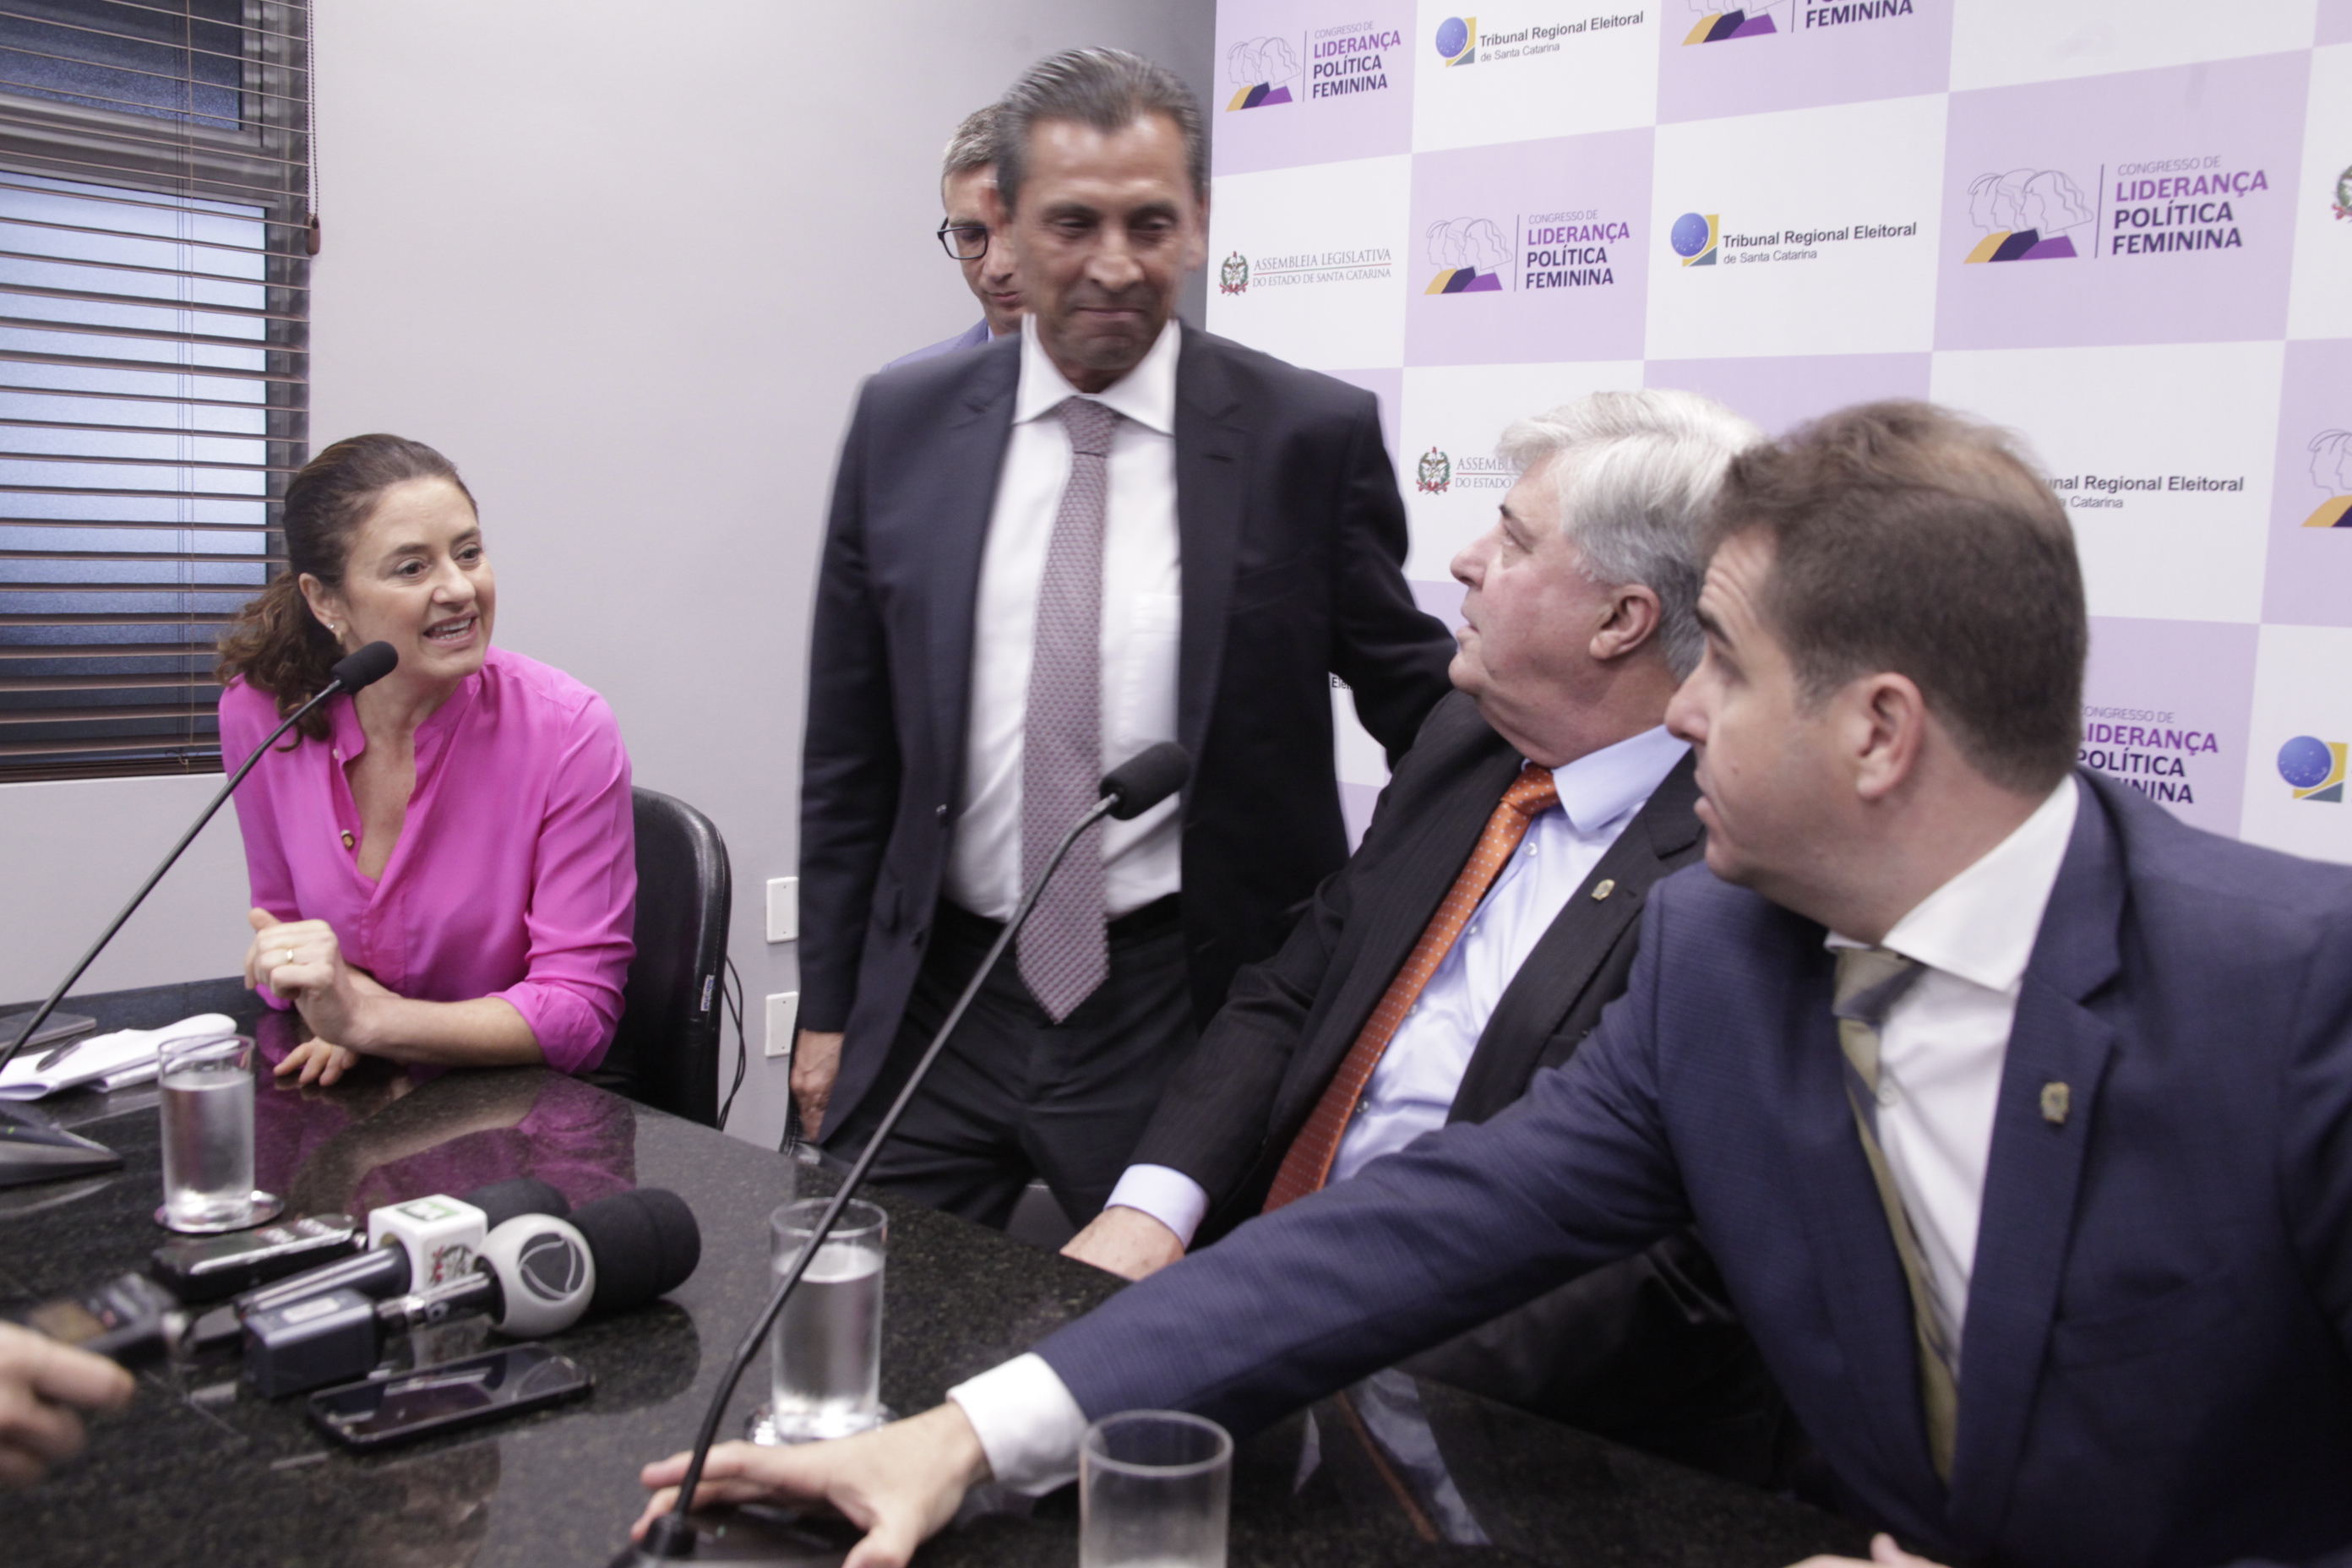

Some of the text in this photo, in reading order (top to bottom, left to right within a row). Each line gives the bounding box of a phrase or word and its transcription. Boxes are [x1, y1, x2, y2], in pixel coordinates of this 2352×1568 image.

[1805, 0, 1914, 29] FEMININA
[1315, 20, 1374, 39] CONGRESSO DE
[1479, 10, 1644, 47] Tribunal Regional Eleitoral
[1315, 30, 1401, 58] LIDERANÇA
[1481, 42, 1560, 62] de Santa Catarina
[1314, 54, 1382, 79] POLÍTICA
[1313, 73, 1387, 99] FEMININA
[2117, 155, 2222, 177] CONGRESSO DE
[2116, 170, 2268, 202] LIDERANÇA
[1528, 210, 1598, 225] CONGRESSO DE
[2115, 199, 2234, 230] POLÍTICA
[1527, 221, 1630, 246] LIDERANÇA
[1723, 221, 1917, 248] Tribunal Regional Eleitoral
[2112, 227, 2242, 255] FEMININA
[1254, 248, 1391, 271] ASSEMBLEIA LEGISLATIVA
[1527, 244, 1607, 268] POLÍTICA
[1723, 249, 1817, 264] de Santa Catarina
[1253, 268, 1391, 287] DO ESTADO DE SANTA CATARINA
[1526, 268, 1614, 289] FEMININA
[1455, 477, 1471, 488] DO
[1473, 477, 1511, 488] ESTADO
[2084, 476, 2162, 493] Regional
[2168, 476, 2244, 492] Eleitoral
[2070, 496, 2124, 508] Catarina
[2082, 705, 2175, 723] ONGRESSO DE
[2084, 722, 2219, 756] IDERANÇA
